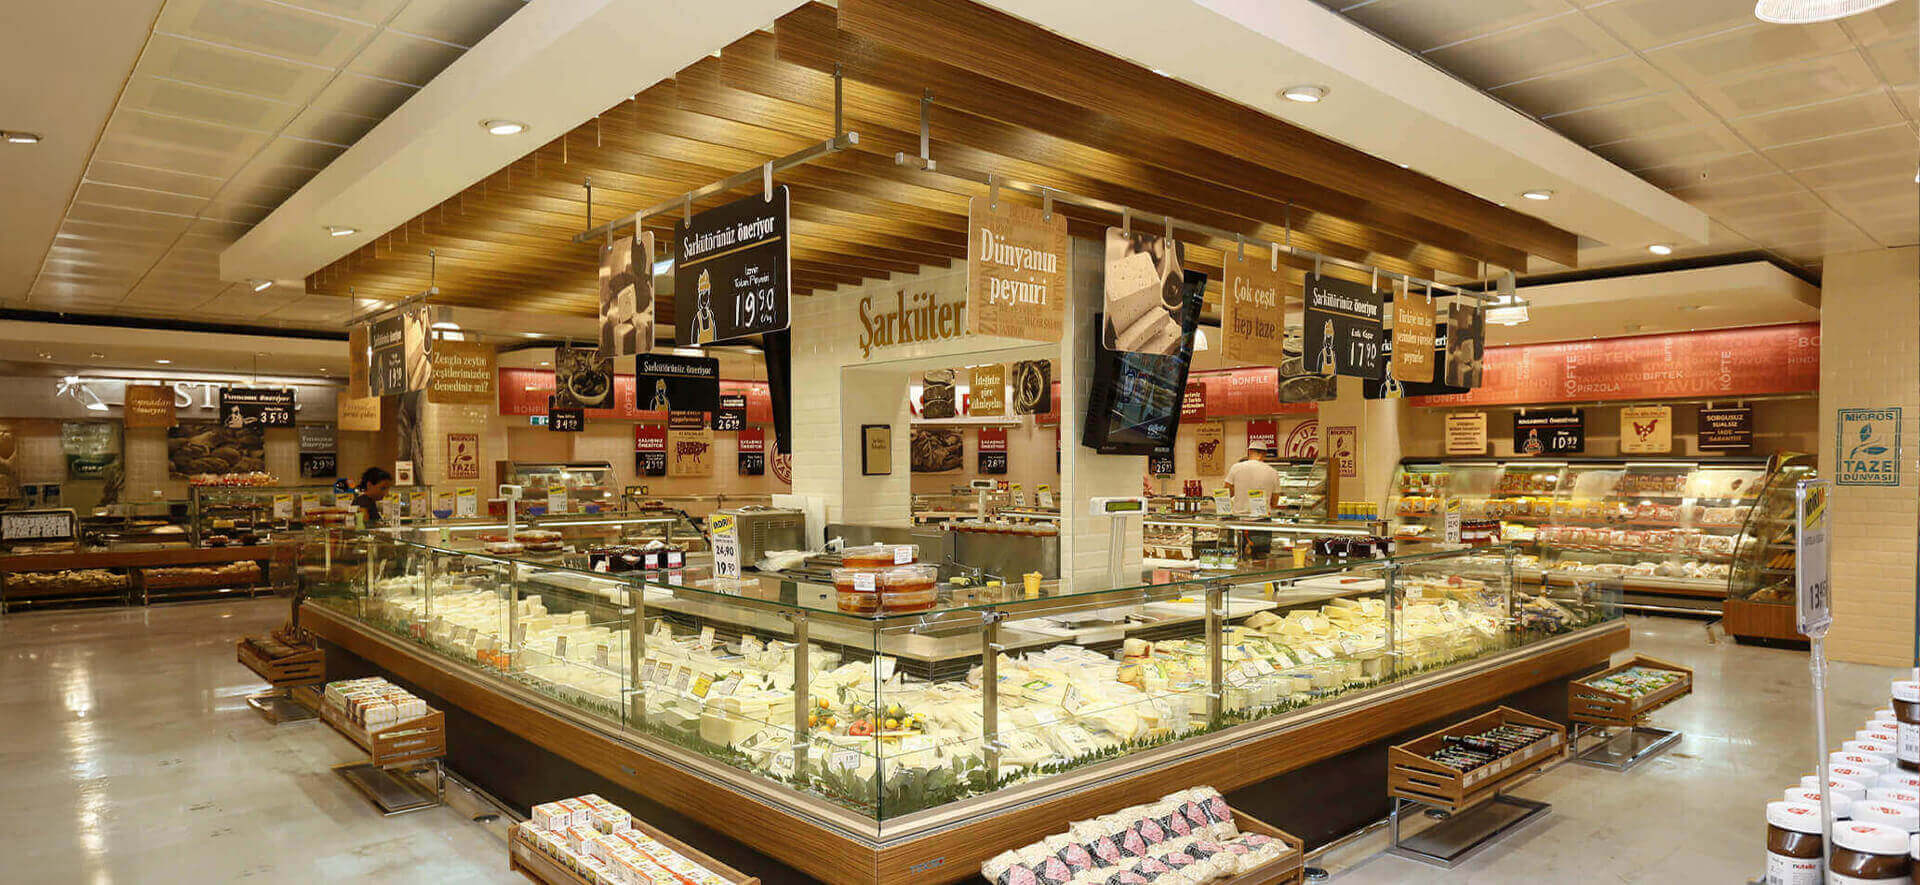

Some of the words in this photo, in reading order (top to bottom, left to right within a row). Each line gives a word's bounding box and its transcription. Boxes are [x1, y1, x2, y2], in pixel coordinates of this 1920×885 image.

[737, 216, 775, 242] öneriyor
[980, 227, 1058, 274] Dünyanın
[989, 276, 1048, 306] peyniri
[1233, 276, 1252, 305] Çok
[1254, 284, 1277, 310] çeşit
[1233, 308, 1253, 340] hep
[1254, 318, 1276, 341] taze
[434, 351, 462, 365] Zengin
[463, 354, 487, 367] zeytin
[1720, 351, 1733, 392] KÖFTE
[434, 380, 472, 393] denediniz
[473, 380, 489, 393] mi?
[1565, 352, 1578, 398] KÖFTE
[1844, 412, 1894, 422] MIGROS
[1843, 460, 1893, 473] TAZE
[1843, 472, 1893, 482] DÜNYASI
